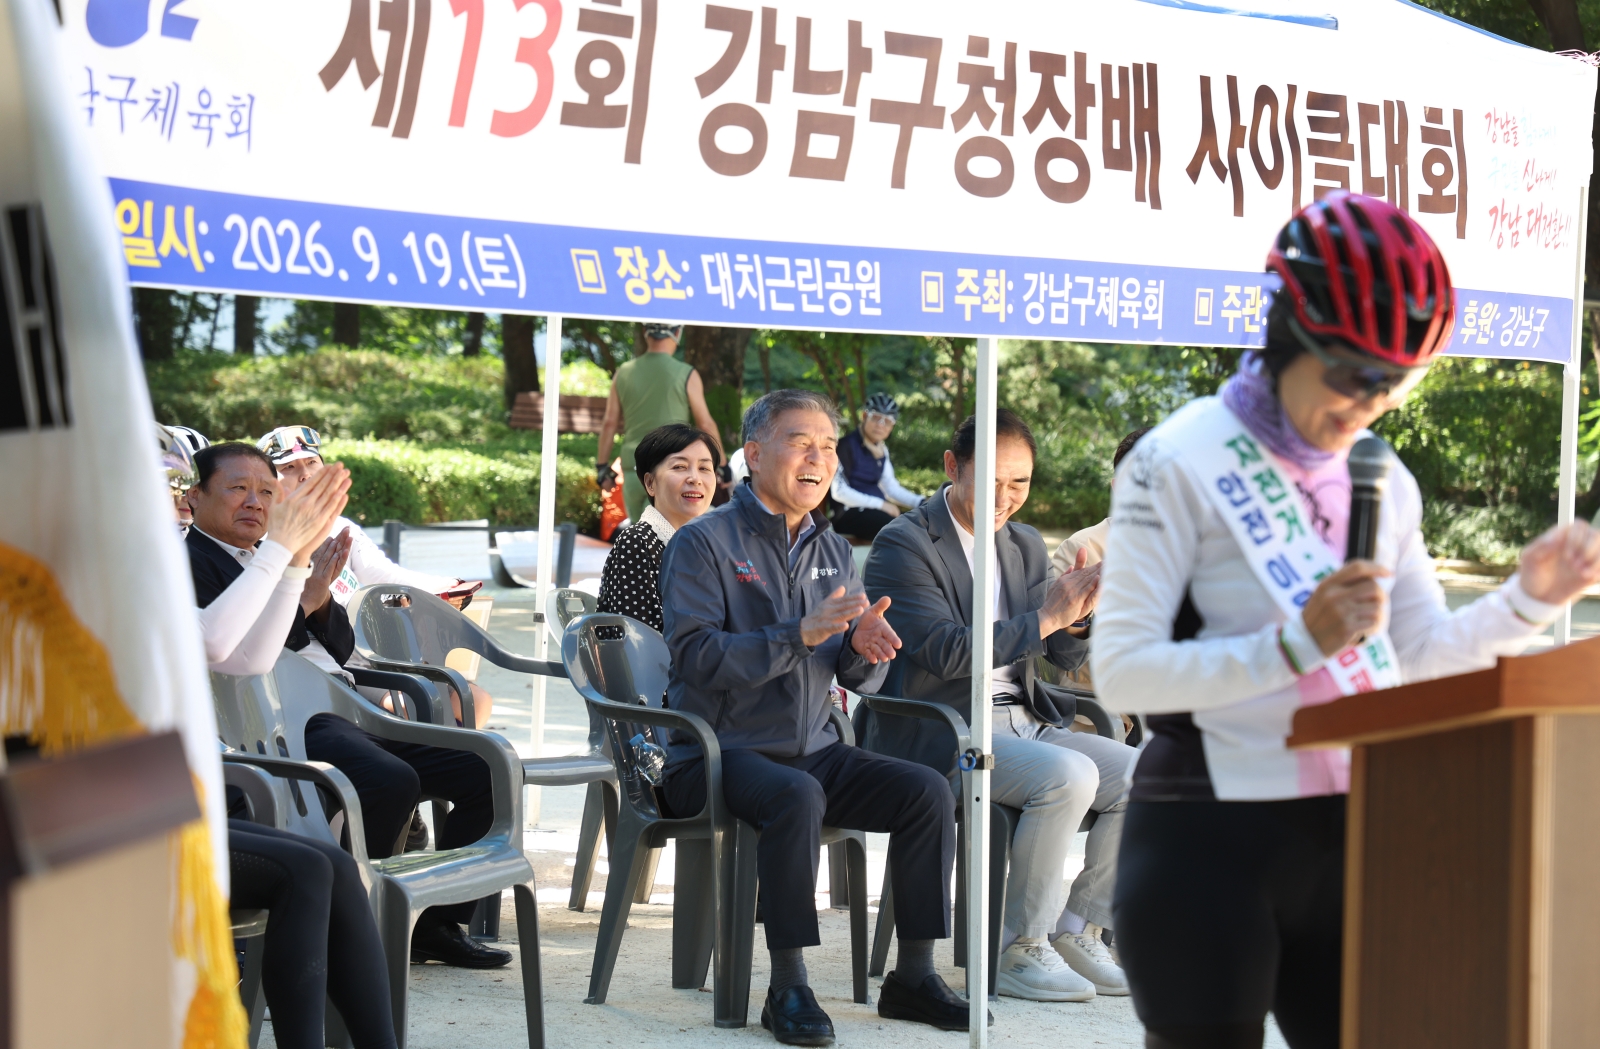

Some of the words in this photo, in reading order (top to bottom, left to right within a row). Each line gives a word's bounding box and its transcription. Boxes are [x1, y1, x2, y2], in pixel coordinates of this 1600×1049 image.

[318, 0, 658, 164] 제13회
[695, 4, 1162, 210] 강남구청장배
[1186, 75, 1468, 239] 사이클대회
[1485, 107, 1519, 147] 강남을
[1523, 158, 1557, 192] 신나게!
[115, 198, 215, 273] 일시:
[224, 214, 349, 281] 2026.
[353, 227, 398, 285] 9.
[403, 231, 527, 298] 19.(토)
[1488, 198, 1523, 250] 강남
[1526, 202, 1572, 250] 대전환!!
[613, 246, 694, 305] 장소:
[702, 252, 882, 315] 대치근린공원
[955, 268, 1014, 322] 주최:
[1022, 272, 1164, 330] 강남구체육회
[1221, 285, 1268, 333] 주관:
[1460, 300, 1499, 345] 후원:
[1500, 305, 1550, 349] 강남구
[1216, 470, 1273, 546] 안전
[1225, 434, 1305, 544] 자전거
[819, 567, 838, 576] 강남구
